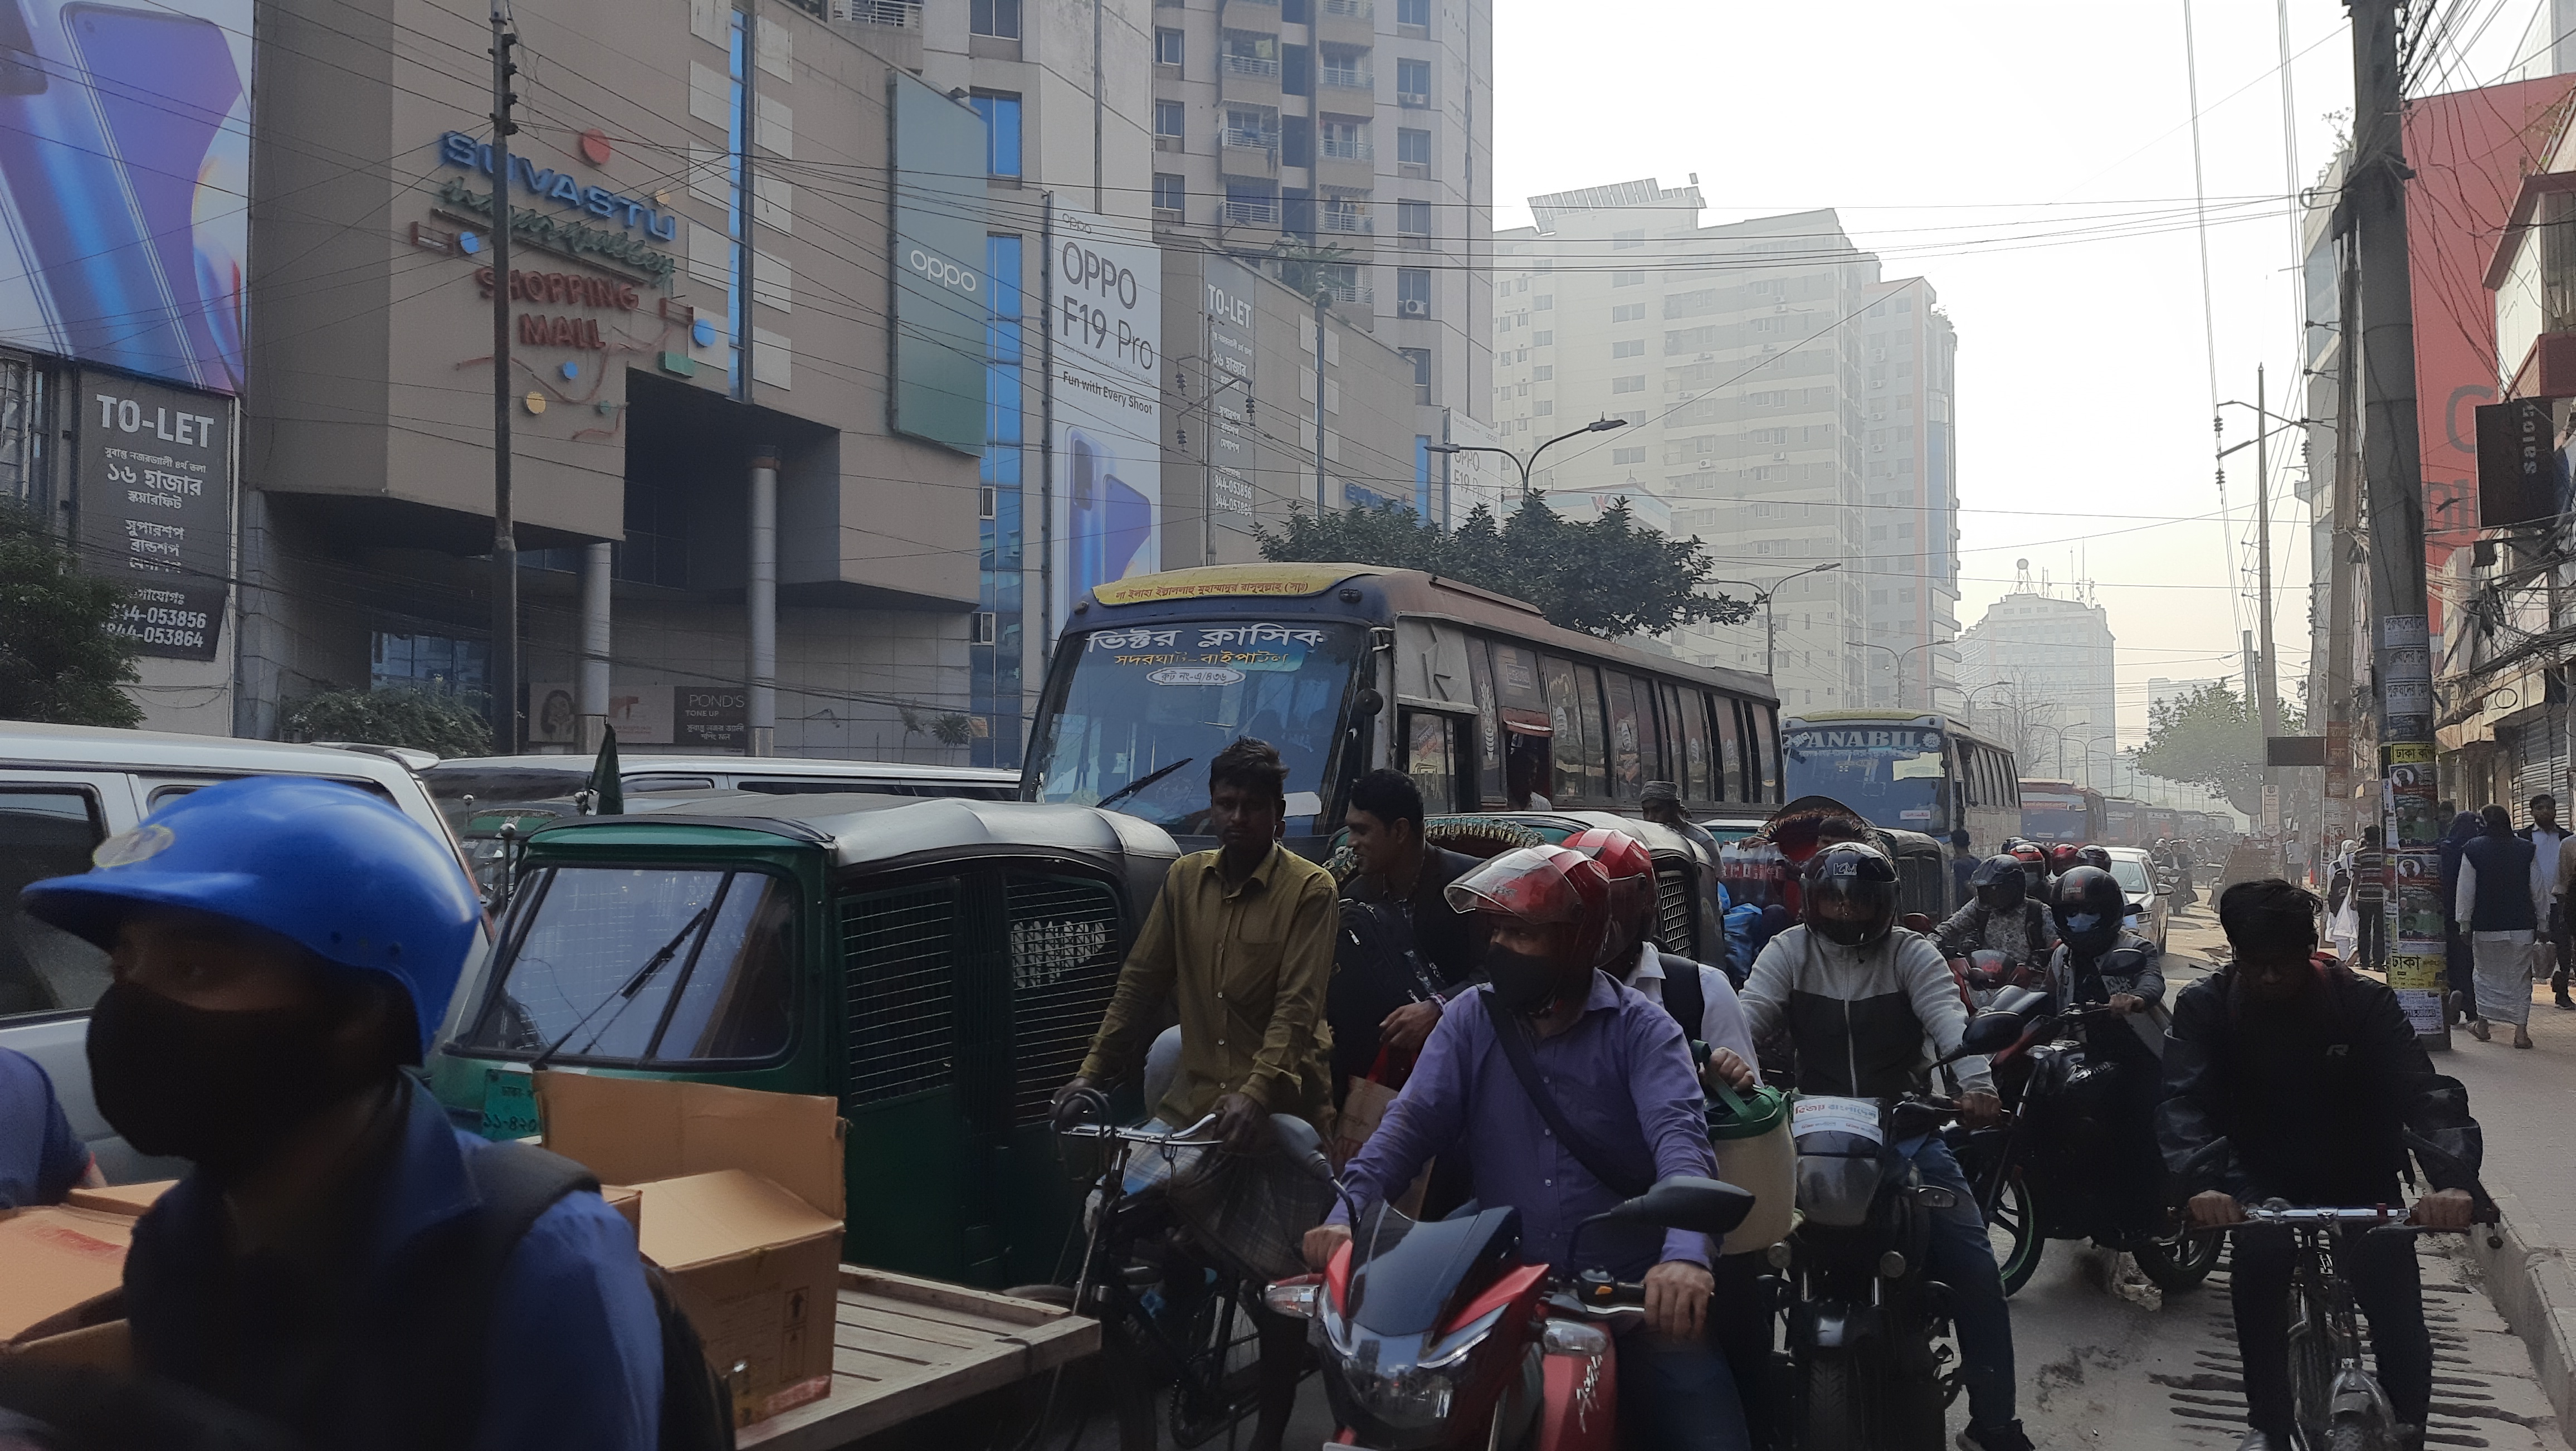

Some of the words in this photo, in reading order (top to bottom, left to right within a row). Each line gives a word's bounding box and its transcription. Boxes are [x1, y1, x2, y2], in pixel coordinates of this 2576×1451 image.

[441, 130, 676, 241] SUVASTU
[911, 249, 976, 291] oppo
[1062, 242, 1136, 309] OPPO
[1208, 283, 1252, 329] TO-LET
[518, 313, 606, 349] MALL
[1063, 295, 1106, 349] F19
[1118, 318, 1153, 370] Pro
[1063, 371, 1080, 387] Fun
[1082, 381, 1102, 396] with
[1104, 386, 1126, 407] Every
[1129, 396, 1152, 415] Shoot
[96, 394, 214, 448] TO-LET
[108, 463, 136, 483] ১৬
[144, 469, 203, 495] হাজার
[1085, 629, 1183, 653] ভিক্টর
[1197, 623, 1325, 647] ক্লাসিক
[690, 694, 744, 707] POND'S
[1806, 731, 1921, 748] ANABIL
